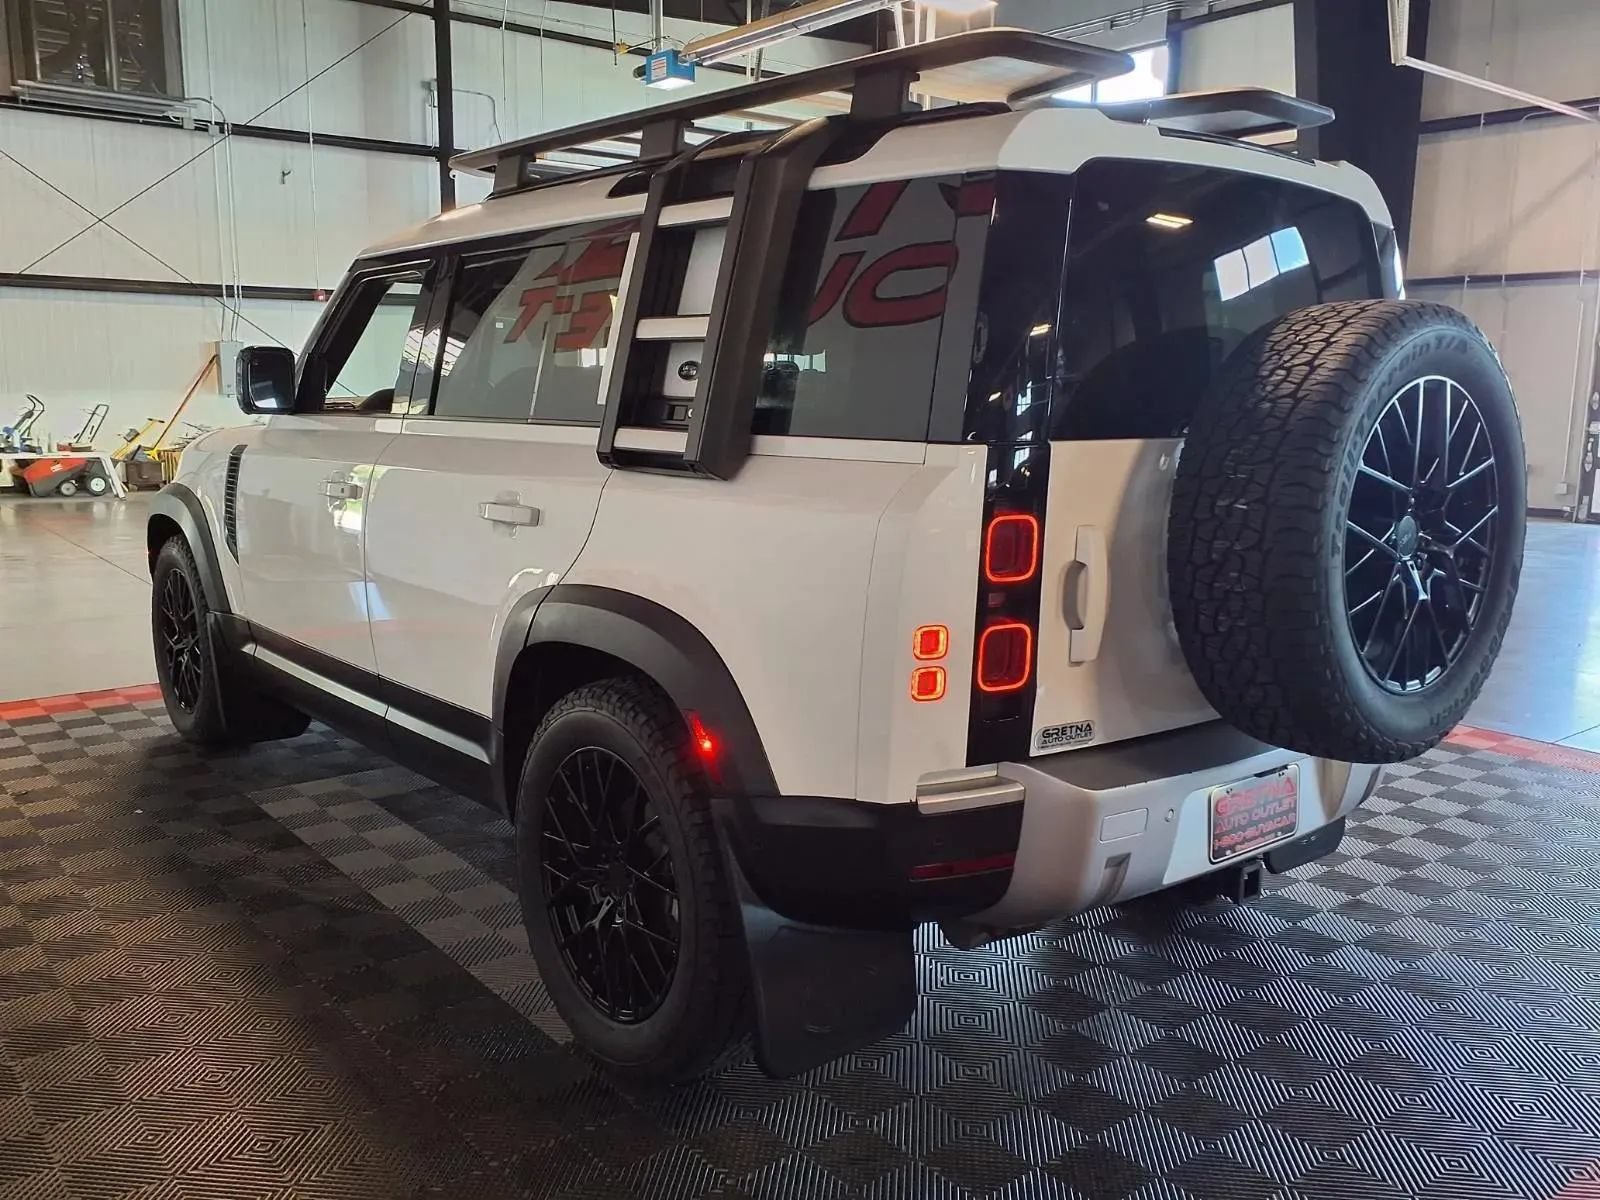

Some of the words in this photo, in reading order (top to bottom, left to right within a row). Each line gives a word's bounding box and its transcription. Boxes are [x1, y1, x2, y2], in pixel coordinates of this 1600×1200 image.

[1041, 722, 1093, 739] GRETNA
[1041, 735, 1064, 745] AUTO
[1214, 812, 1250, 835] AUTO
[1252, 796, 1297, 821] OUTLET
